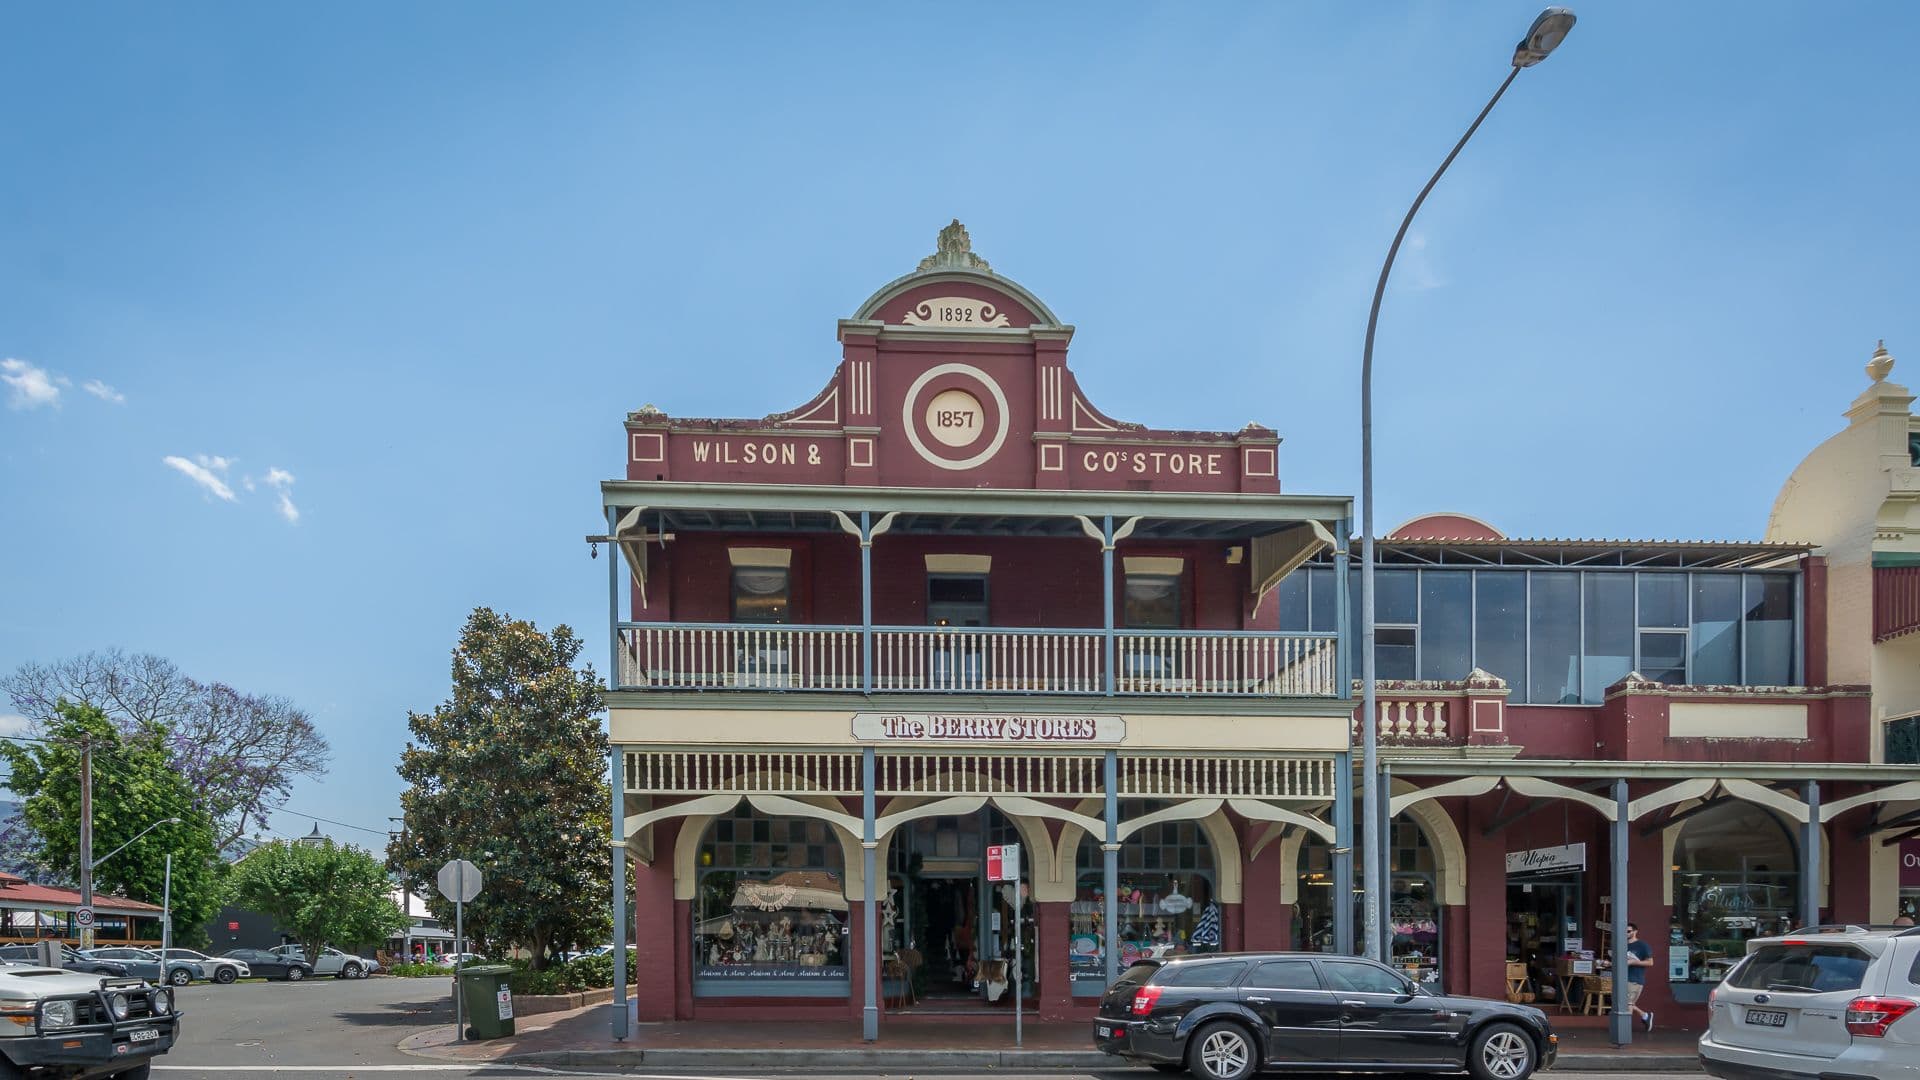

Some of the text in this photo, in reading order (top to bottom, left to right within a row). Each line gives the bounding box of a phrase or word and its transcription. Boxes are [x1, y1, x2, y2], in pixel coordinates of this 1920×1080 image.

[940, 307, 973, 322] 1892
[937, 410, 974, 428] 1857
[692, 440, 821, 466] WILSON &
[1132, 452, 1222, 475] STORE
[881, 714, 1097, 740] The BERRY STORES
[1520, 850, 1556, 868] Utopia
[80, 912, 91, 922] 50
